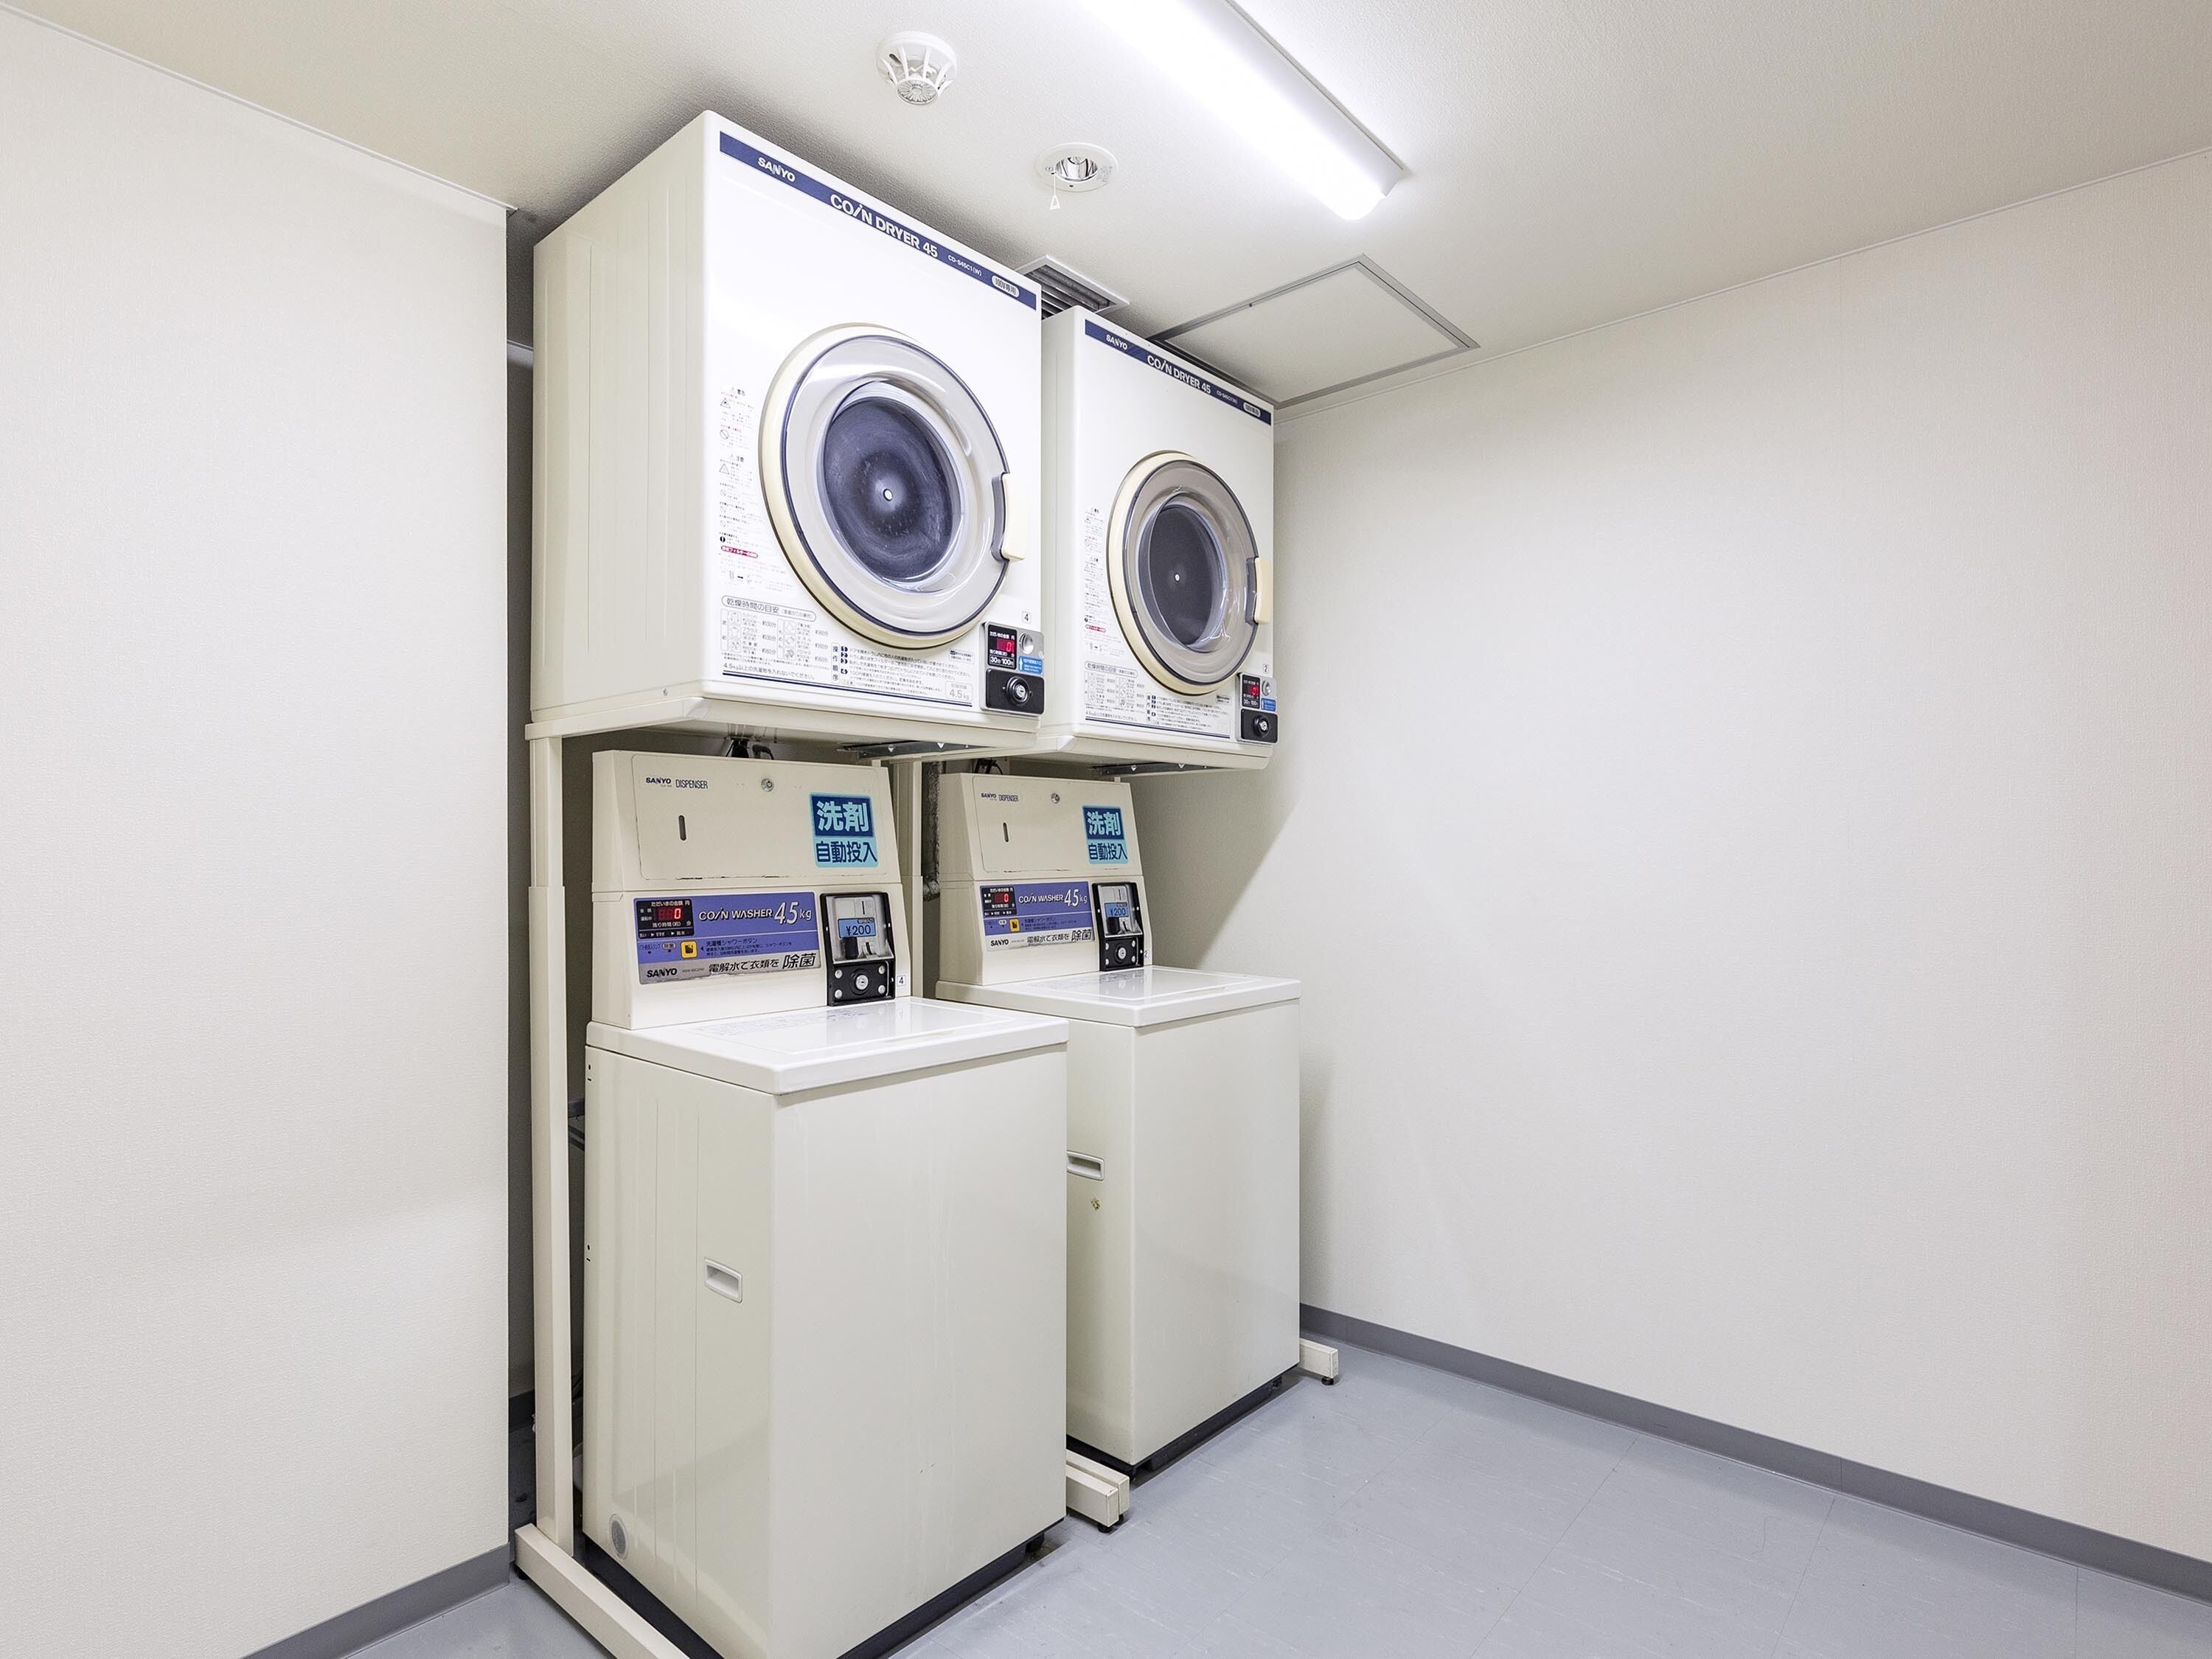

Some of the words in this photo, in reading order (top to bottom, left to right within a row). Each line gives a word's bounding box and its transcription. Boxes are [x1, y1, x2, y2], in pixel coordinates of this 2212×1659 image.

[757, 156, 796, 182] SANYO
[875, 215, 921, 250] DRYER
[922, 241, 939, 258] 45
[1106, 334, 1128, 350] SANYO
[1173, 366, 1200, 389] DRYER
[1201, 382, 1211, 394] 45
[726, 597, 779, 614] 乾燥時間の目安
[1023, 613, 1029, 622] 4
[1006, 641, 1012, 652] 0
[675, 779, 708, 790] DISPENSER
[816, 801, 870, 833] 洗剤
[1086, 811, 1121, 836] 洗剤
[815, 841, 877, 863] 自動投入
[1088, 843, 1128, 860] 自動投入
[1004, 894, 1009, 902] 0
[1037, 894, 1063, 902] WASHER
[674, 908, 681, 919] 0
[731, 908, 773, 919] WASHER
[1110, 908, 1126, 917] ¥200
[846, 925, 871, 936] ¥200
[1026, 933, 1070, 944] 電解水で衣類を
[1071, 929, 1092, 942] 除菌
[990, 939, 1009, 947] SANYO
[709, 959, 779, 973] 電解水で衣類を
[782, 953, 816, 970] 除菌
[647, 967, 678, 978] SANYO
[899, 976, 904, 985] 4
